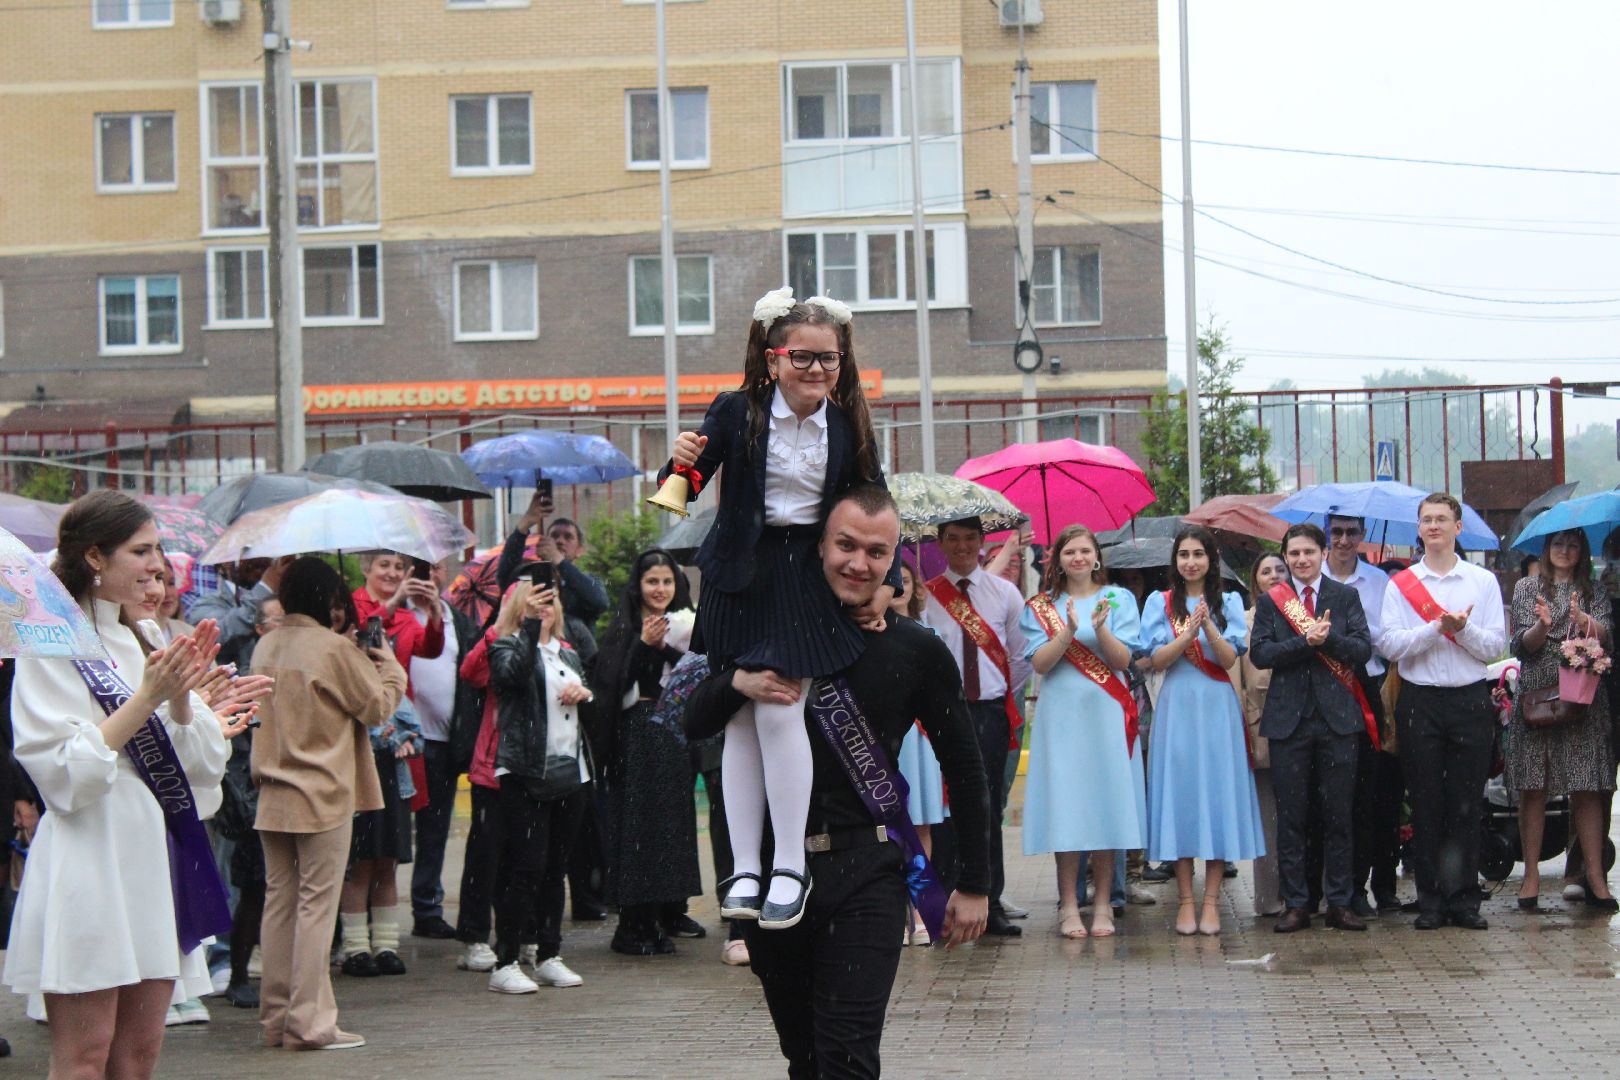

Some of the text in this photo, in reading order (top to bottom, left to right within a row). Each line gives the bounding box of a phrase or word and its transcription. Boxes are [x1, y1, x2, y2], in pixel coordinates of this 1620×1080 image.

[314, 383, 593, 409] ОРАНЖЕВОЕ ДЕТСТВО
[15, 622, 76, 645] FROZEN
[149, 764, 192, 814] 2023
